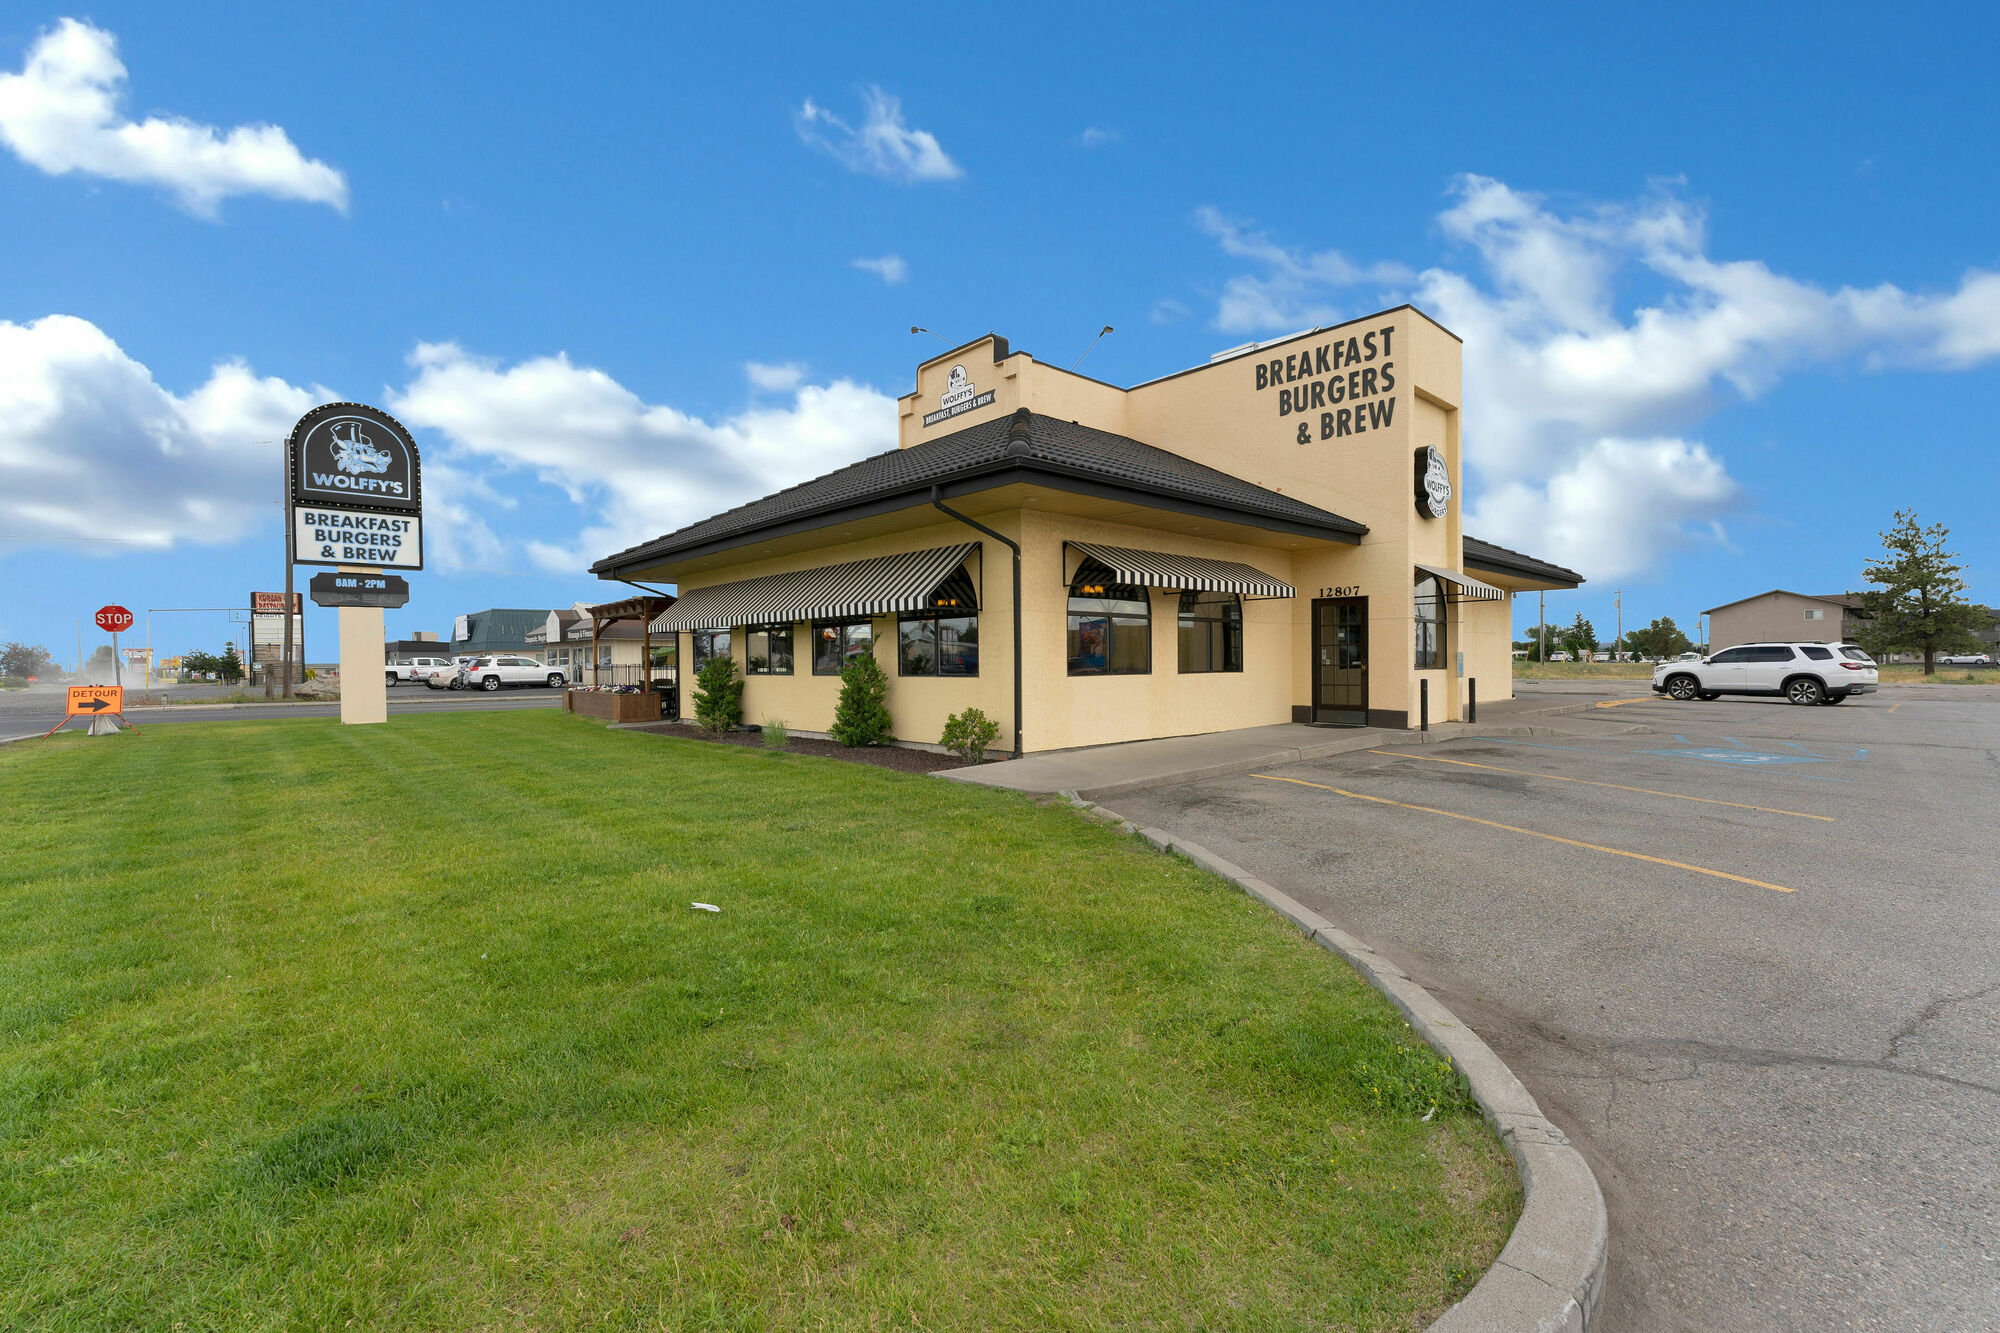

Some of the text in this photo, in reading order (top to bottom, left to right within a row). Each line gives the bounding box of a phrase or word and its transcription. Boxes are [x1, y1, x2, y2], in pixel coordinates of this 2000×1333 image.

[1256, 326, 1394, 390] BREAKFAST
[943, 388, 972, 405] WOLFFY'S
[1279, 362, 1395, 416] BURGERS
[952, 401, 972, 415] BURGERS
[973, 399, 977, 407] &
[978, 394, 991, 405] BREW
[1296, 397, 1396, 445] & BREW
[312, 472, 403, 494] WOLFFY'S
[1427, 479, 1449, 496] WOLFFY'S
[304, 512, 410, 533] BREAKFAST
[315, 529, 402, 547] BURGERS
[321, 546, 397, 561] & BREW
[336, 578, 357, 587] 8AM
[365, 580, 386, 589] 2PM
[1319, 585, 1361, 598] 12807
[329, 593, 392, 603] OPEN
[97, 613, 132, 624] STOP
[73, 690, 118, 698] DETOUR
